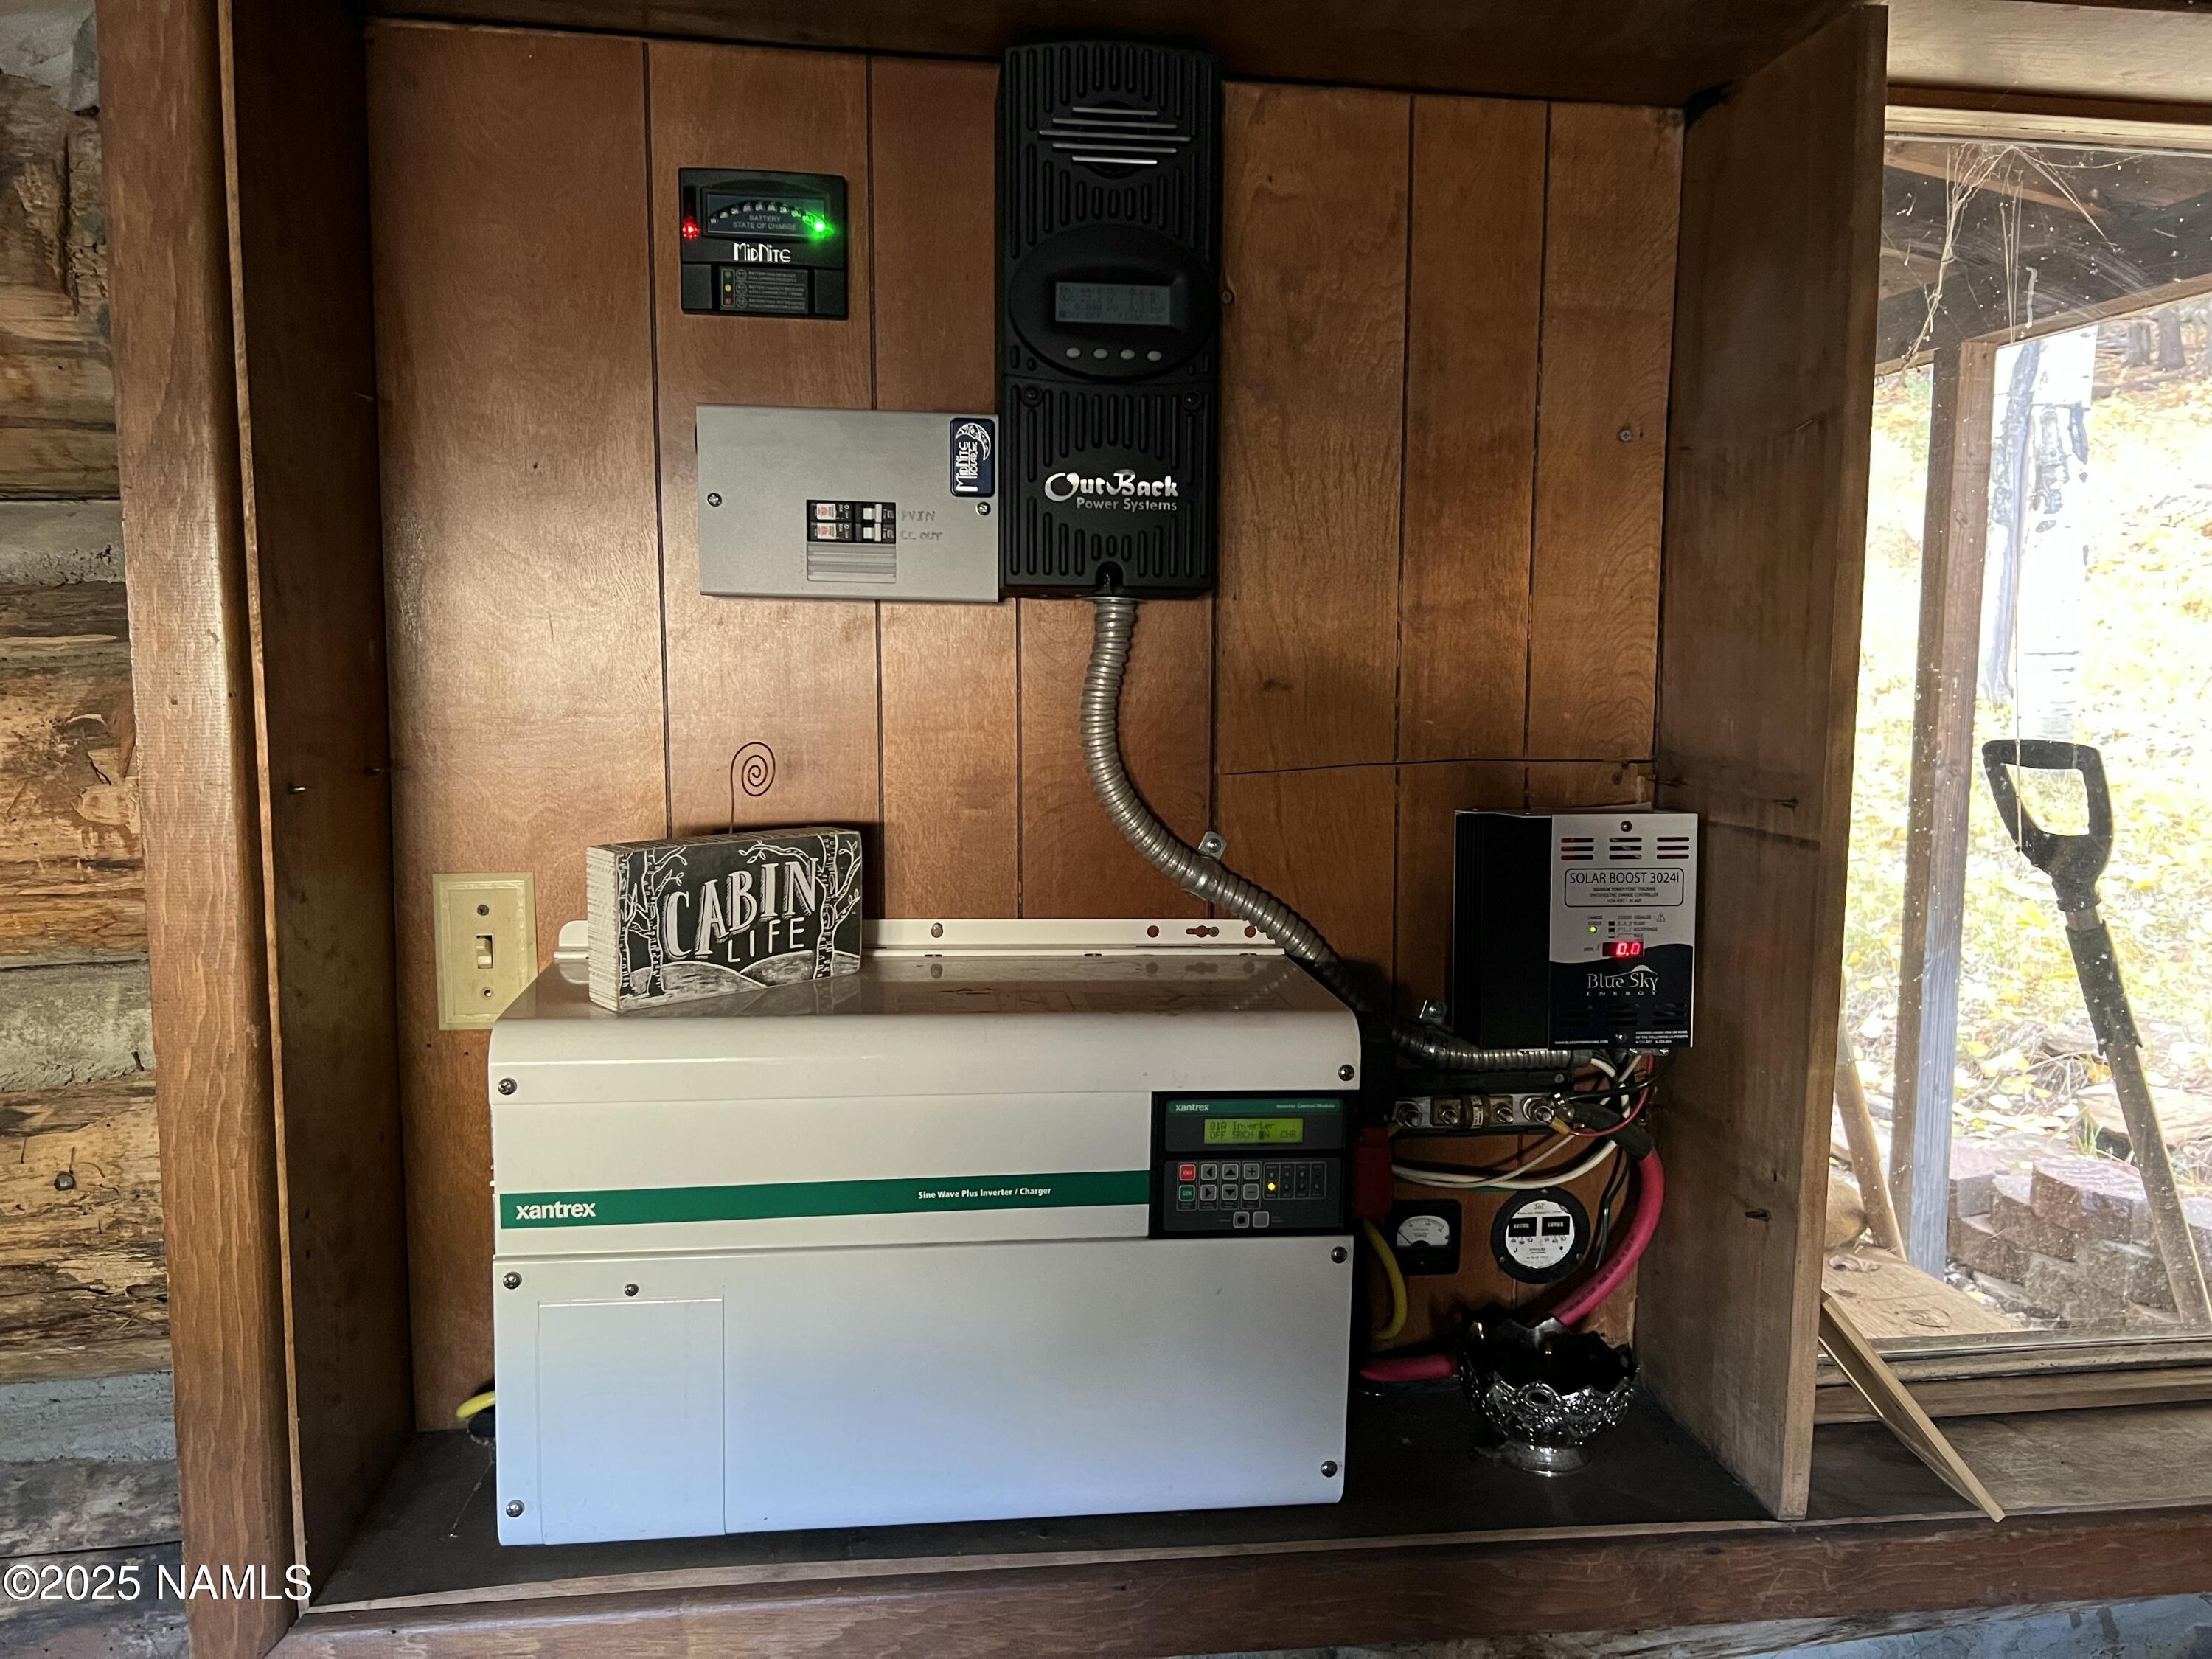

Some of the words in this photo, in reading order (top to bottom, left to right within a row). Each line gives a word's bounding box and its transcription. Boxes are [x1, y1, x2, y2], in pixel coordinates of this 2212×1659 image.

[749, 215, 782, 223] BATTERY
[1044, 469, 1179, 502] OutBack
[1076, 497, 1119, 510] Power
[1123, 498, 1178, 513] Systems
[1569, 872, 1607, 884] SOLAR
[1609, 872, 1648, 884] BOOST
[1649, 872, 1680, 883] 3024i
[664, 858, 818, 959] CABIN
[728, 917, 805, 964] LIFE
[1617, 942, 1641, 956] 0.0
[1586, 973, 1624, 989] Blue
[1629, 973, 1660, 991] Sky
[1175, 1104, 1209, 1112] xantrex
[1233, 1121, 1274, 1130] Inverter
[1209, 1131, 1226, 1139] OFF
[918, 1191, 936, 1199] Sine
[937, 1190, 960, 1199] Wave
[961, 1189, 978, 1197] Plus
[980, 1189, 1012, 1197] Inverter
[1020, 1187, 1051, 1197] Charger
[515, 1201, 597, 1220] xantrex
